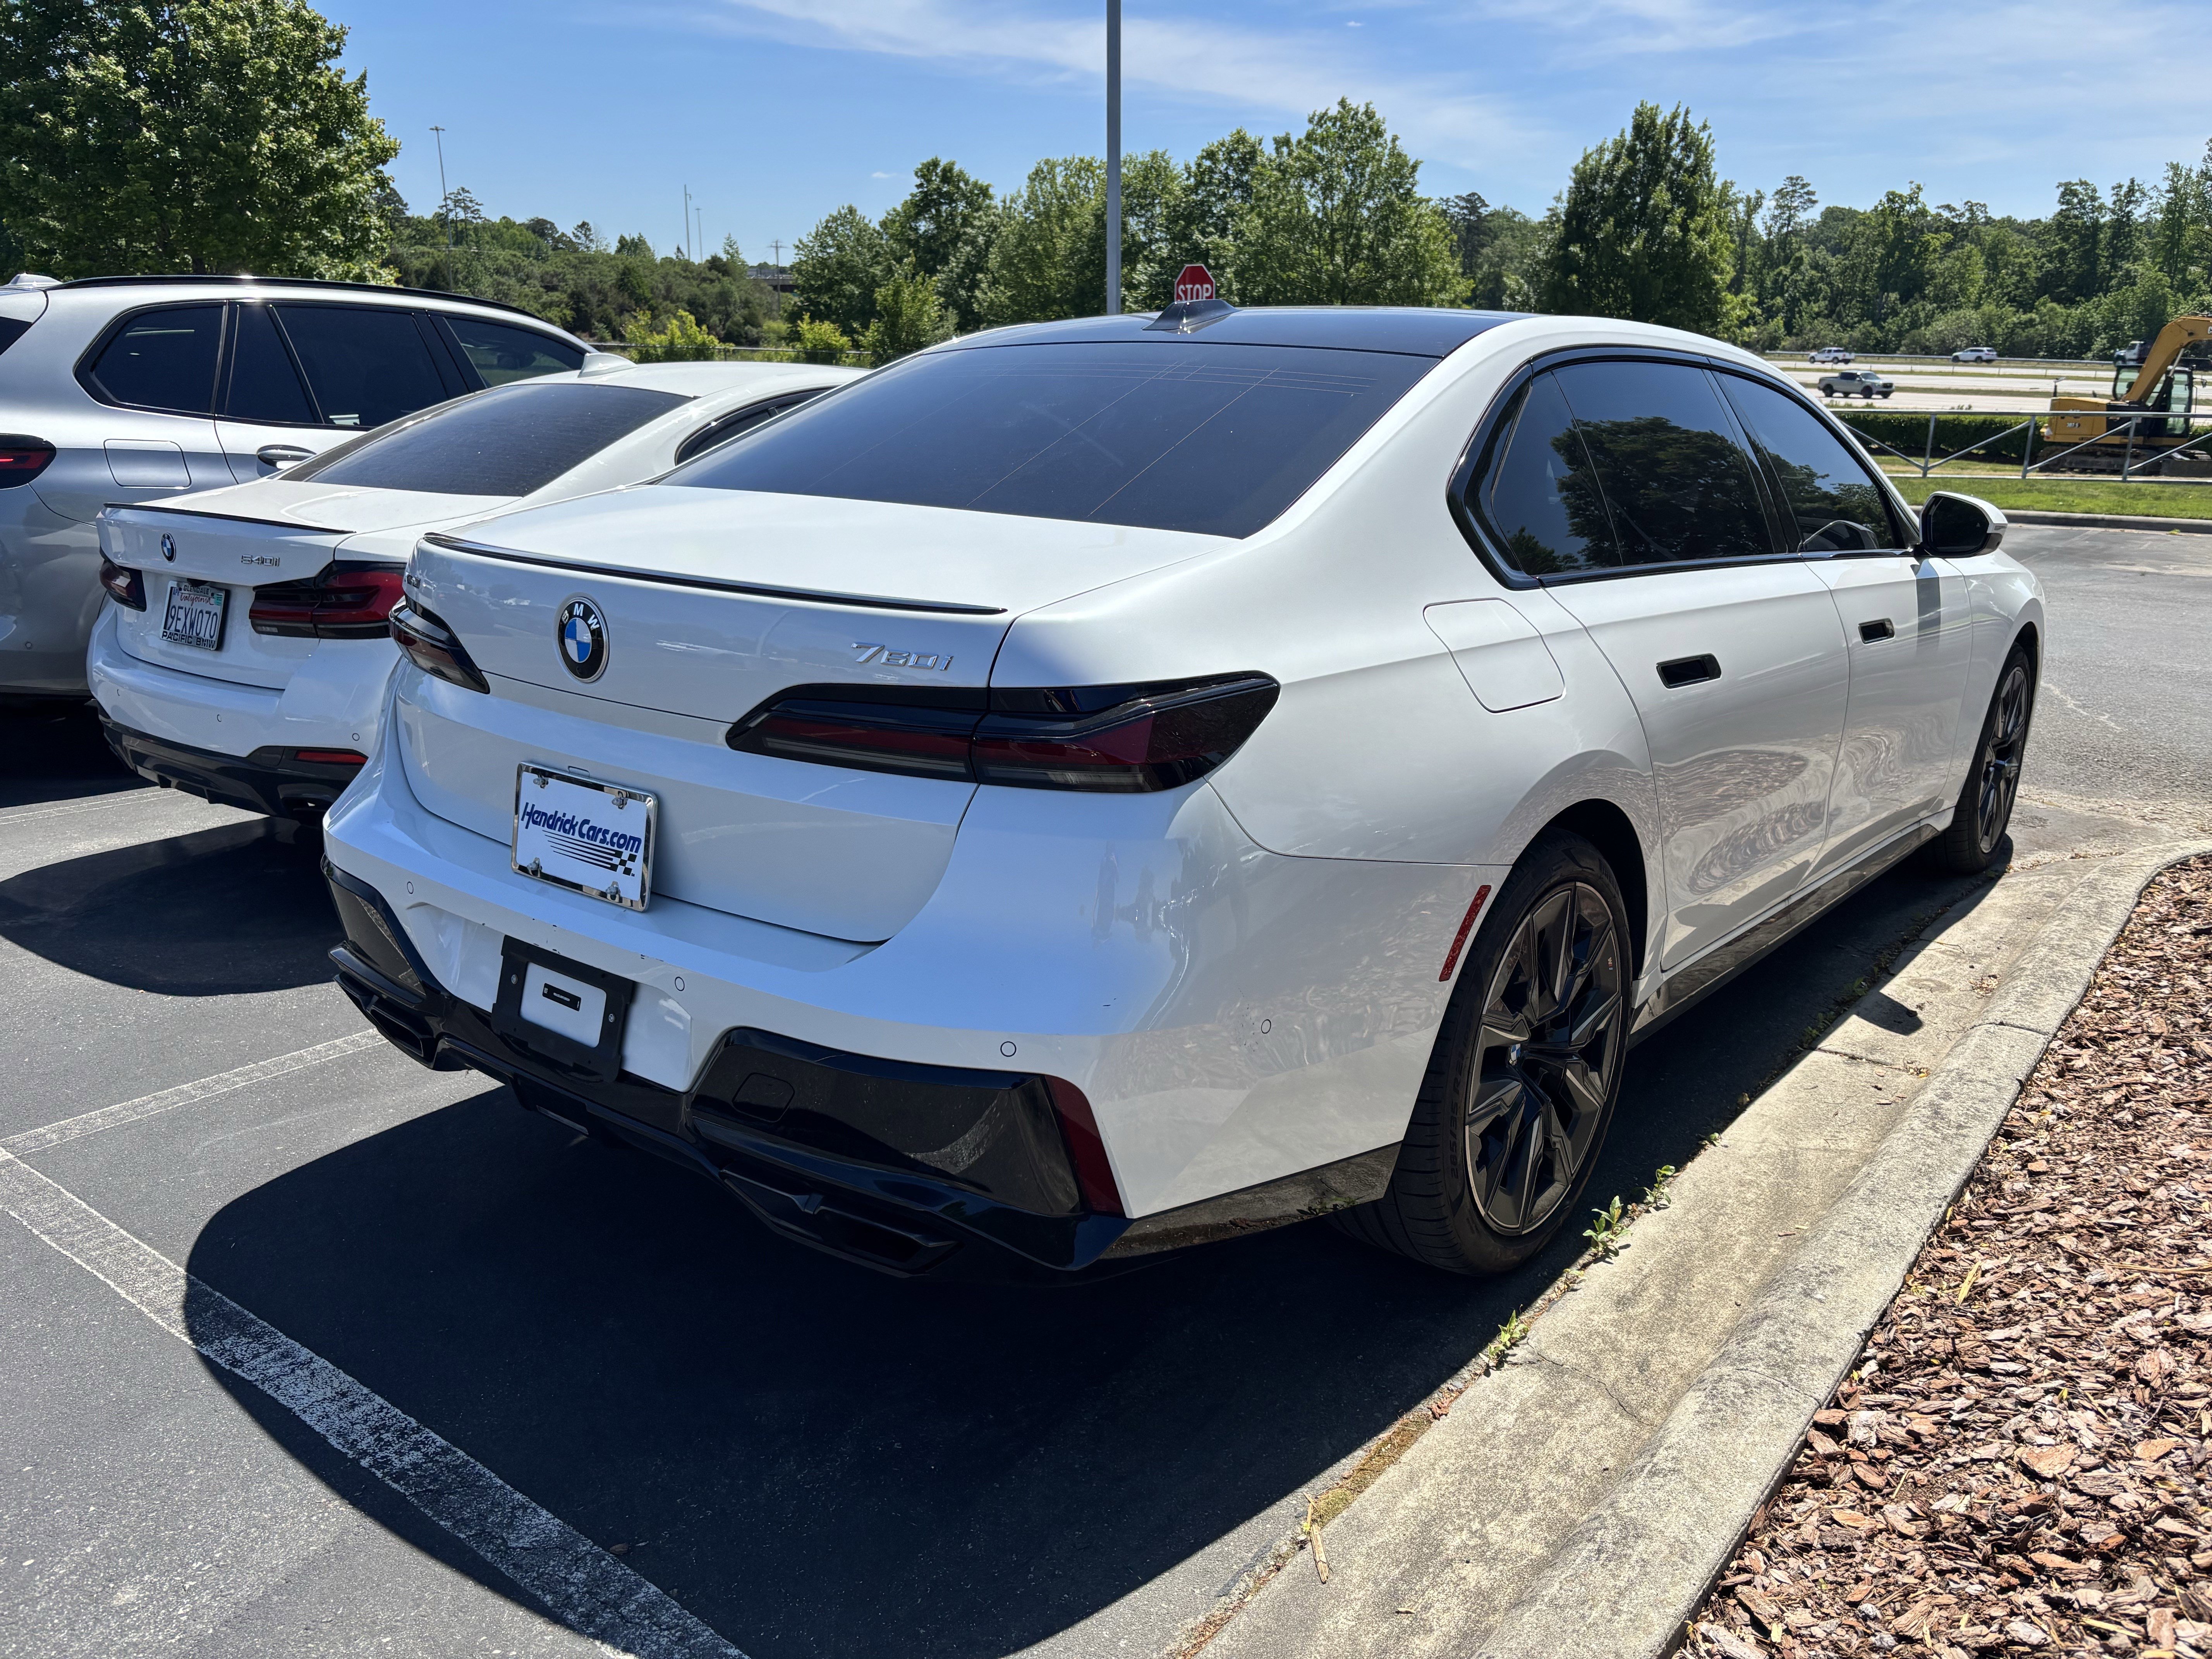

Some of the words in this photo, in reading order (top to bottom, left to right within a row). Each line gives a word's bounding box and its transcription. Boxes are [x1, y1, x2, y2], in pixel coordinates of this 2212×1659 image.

[1178, 284, 1212, 301] STOP
[241, 555, 280, 567] 540i
[183, 585, 210, 595] GLENDALE
[167, 605, 218, 639] 9EXW070
[562, 603, 600, 630] BMW
[162, 631, 192, 644] PACIFIC
[196, 638, 216, 649] BMW
